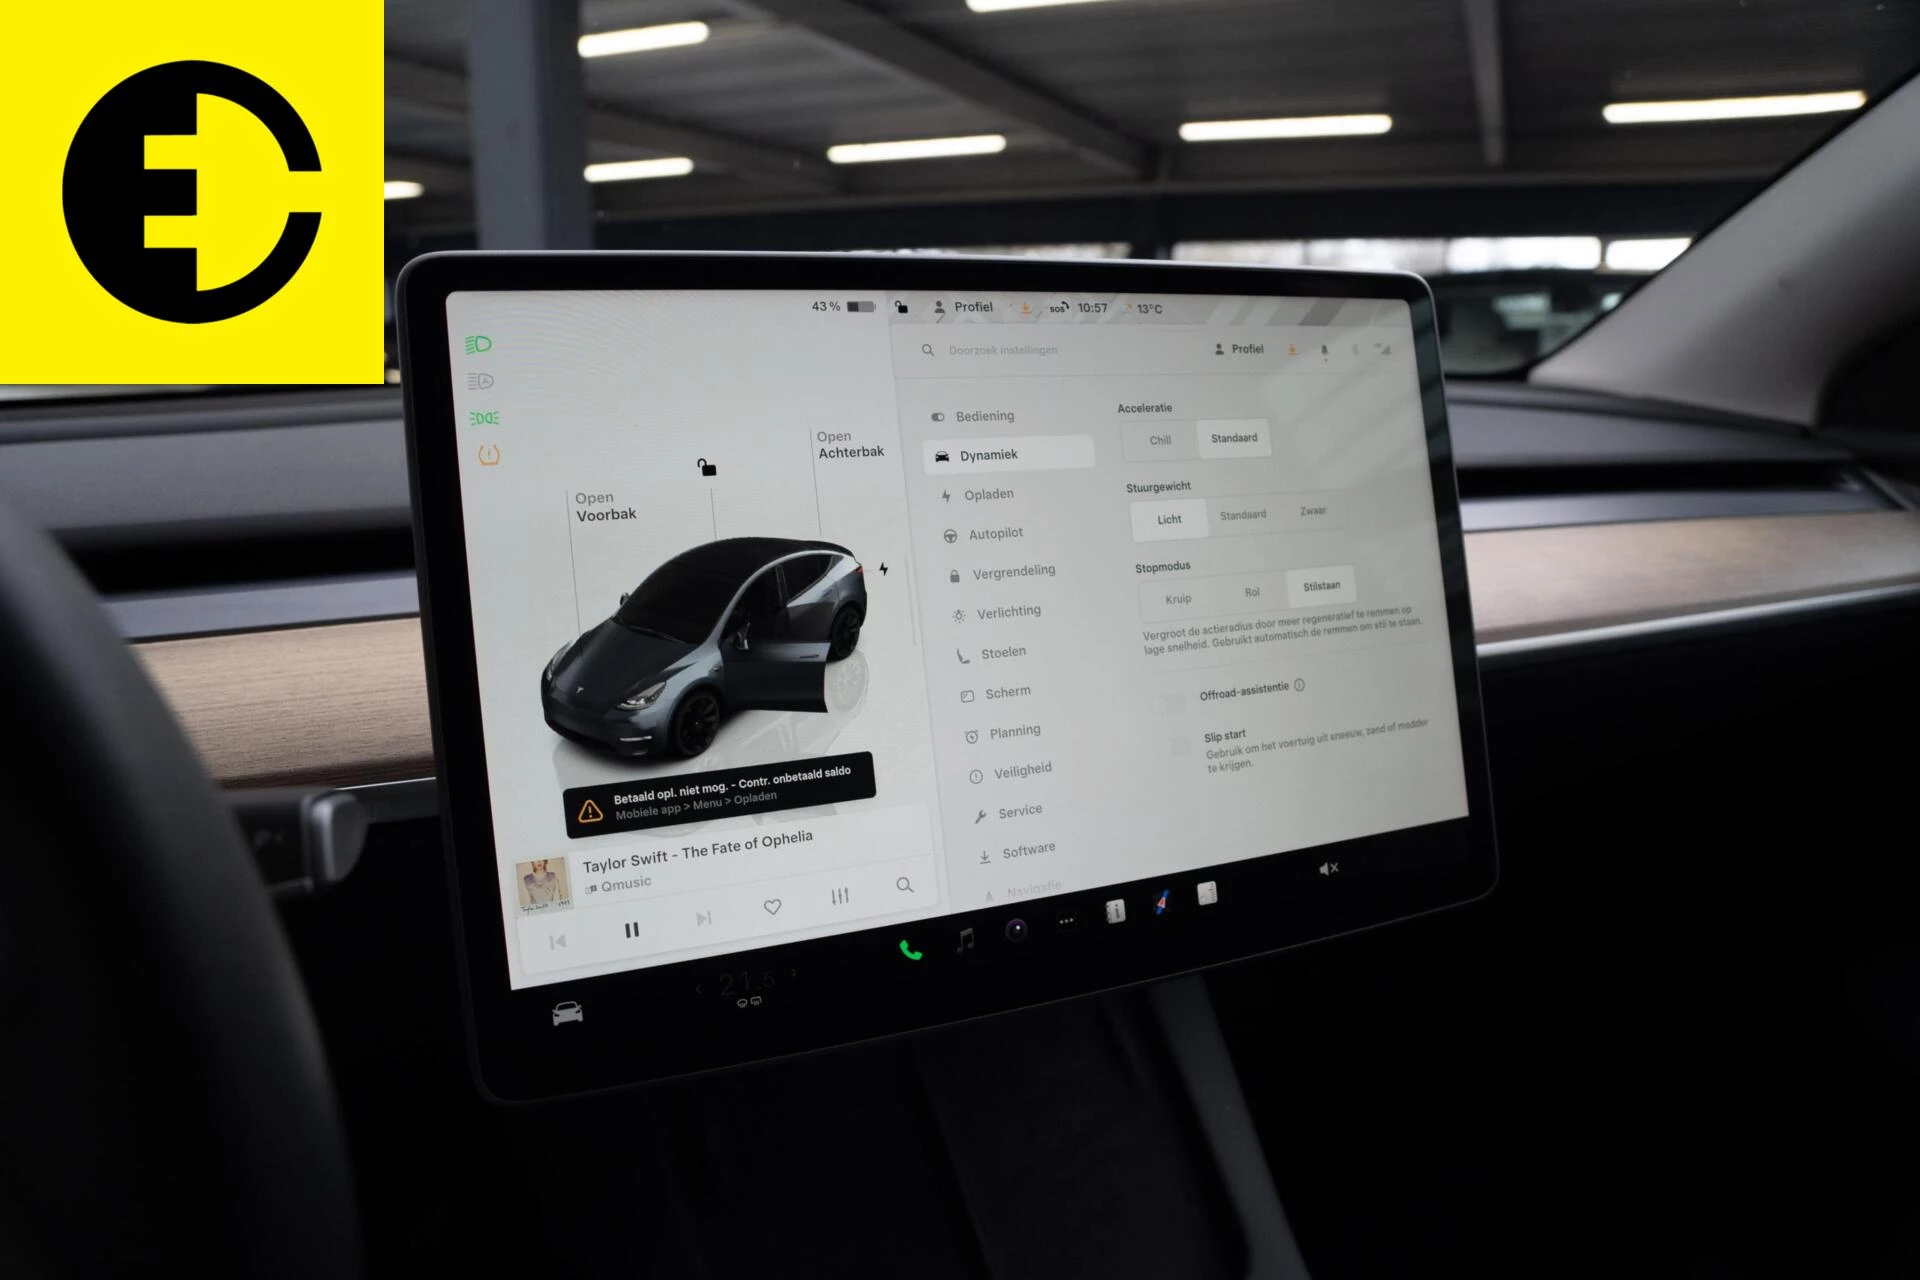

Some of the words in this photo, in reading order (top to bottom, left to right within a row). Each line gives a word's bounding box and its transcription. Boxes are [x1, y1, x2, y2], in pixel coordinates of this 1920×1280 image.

[812, 301, 826, 312] 43
[954, 301, 993, 313] Profiel
[1078, 303, 1108, 313] 10:57
[1137, 304, 1163, 314] 13°C
[949, 344, 997, 356] Doorzoek
[1000, 344, 1058, 357] instellingen
[1232, 344, 1264, 355] Profiel
[1118, 403, 1173, 414] Acceleratie
[956, 411, 1015, 423] Bediening
[817, 430, 852, 445] Open
[1150, 435, 1172, 446] Chill
[1211, 432, 1258, 444] Standaard
[818, 445, 885, 460] Achterbak
[960, 449, 1018, 463] Dynamiek
[1126, 481, 1192, 495] Stuurgewicht
[575, 491, 614, 507] Open
[965, 489, 1014, 503] Opladen
[576, 507, 637, 522] Voorbak
[1220, 509, 1267, 521] Standaard
[1300, 505, 1327, 516] Zwaar
[1158, 514, 1182, 526] Licht
[969, 527, 1024, 542] Autopilot
[973, 565, 1056, 582] Vergrendeling
[1135, 561, 1191, 574] Stopmodus
[1245, 587, 1260, 598] Rol
[1303, 580, 1341, 592] Stilstaan
[1165, 594, 1192, 606] Kruip
[977, 605, 1041, 620] Verlichting
[1142, 628, 1186, 642] Vergroot
[1188, 627, 1200, 637] de
[1202, 622, 1254, 635] actieradius
[1255, 619, 1276, 629] door
[1278, 616, 1300, 626] meer
[1302, 610, 1355, 625] regeneratief
[1356, 609, 1365, 618] te
[1366, 606, 1400, 617] remmen
[1402, 605, 1412, 616] op
[1144, 644, 1165, 656] lage
[1167, 639, 1210, 653] snelheid.
[1212, 635, 1252, 648] Gebruikt
[1254, 629, 1309, 644] automatisch
[1311, 627, 1322, 637] de
[1323, 624, 1358, 636] remmen
[1359, 623, 1373, 632] om
[1374, 619, 1387, 630] stil
[1388, 619, 1397, 628] te
[982, 646, 1027, 660] Stoelen
[985, 686, 1031, 700] Scherm
[1200, 682, 1290, 701] Offroad-assistentie
[990, 724, 1041, 740] Planning
[1204, 732, 1223, 744] Slip
[1224, 729, 1247, 741] start
[1206, 746, 1243, 760] Gebruik
[1245, 745, 1260, 754] om
[1261, 741, 1277, 752] het
[1279, 735, 1316, 750] voertuig
[1317, 733, 1328, 744] uit
[1366, 724, 1386, 736] zand
[1387, 721, 1396, 732] of
[1397, 718, 1429, 730] modder
[994, 761, 1053, 780] Veiligheid
[1208, 763, 1218, 774] te
[1219, 758, 1255, 773] krijgen.
[614, 791, 655, 805] Betaald
[657, 788, 677, 801] opl.
[679, 785, 700, 798] niet
[702, 782, 729, 796] mog.
[738, 777, 771, 790] Contr.
[773, 768, 823, 785] onbetaald
[824, 765, 851, 779] saldo
[616, 806, 659, 821] Mobiele
[661, 804, 681, 817] app
[693, 799, 723, 811] Menu
[734, 790, 777, 805] Opladen
[999, 804, 1043, 820] Service
[583, 857, 627, 875] Taylor
[631, 850, 668, 867] Swift
[681, 847, 708, 860] The
[712, 841, 741, 856] Fate
[745, 837, 758, 850] of
[762, 830, 813, 850] Ophelia
[1003, 841, 1056, 859] Software
[601, 874, 652, 893] Qmusic
[719, 970, 776, 997] 21.5
